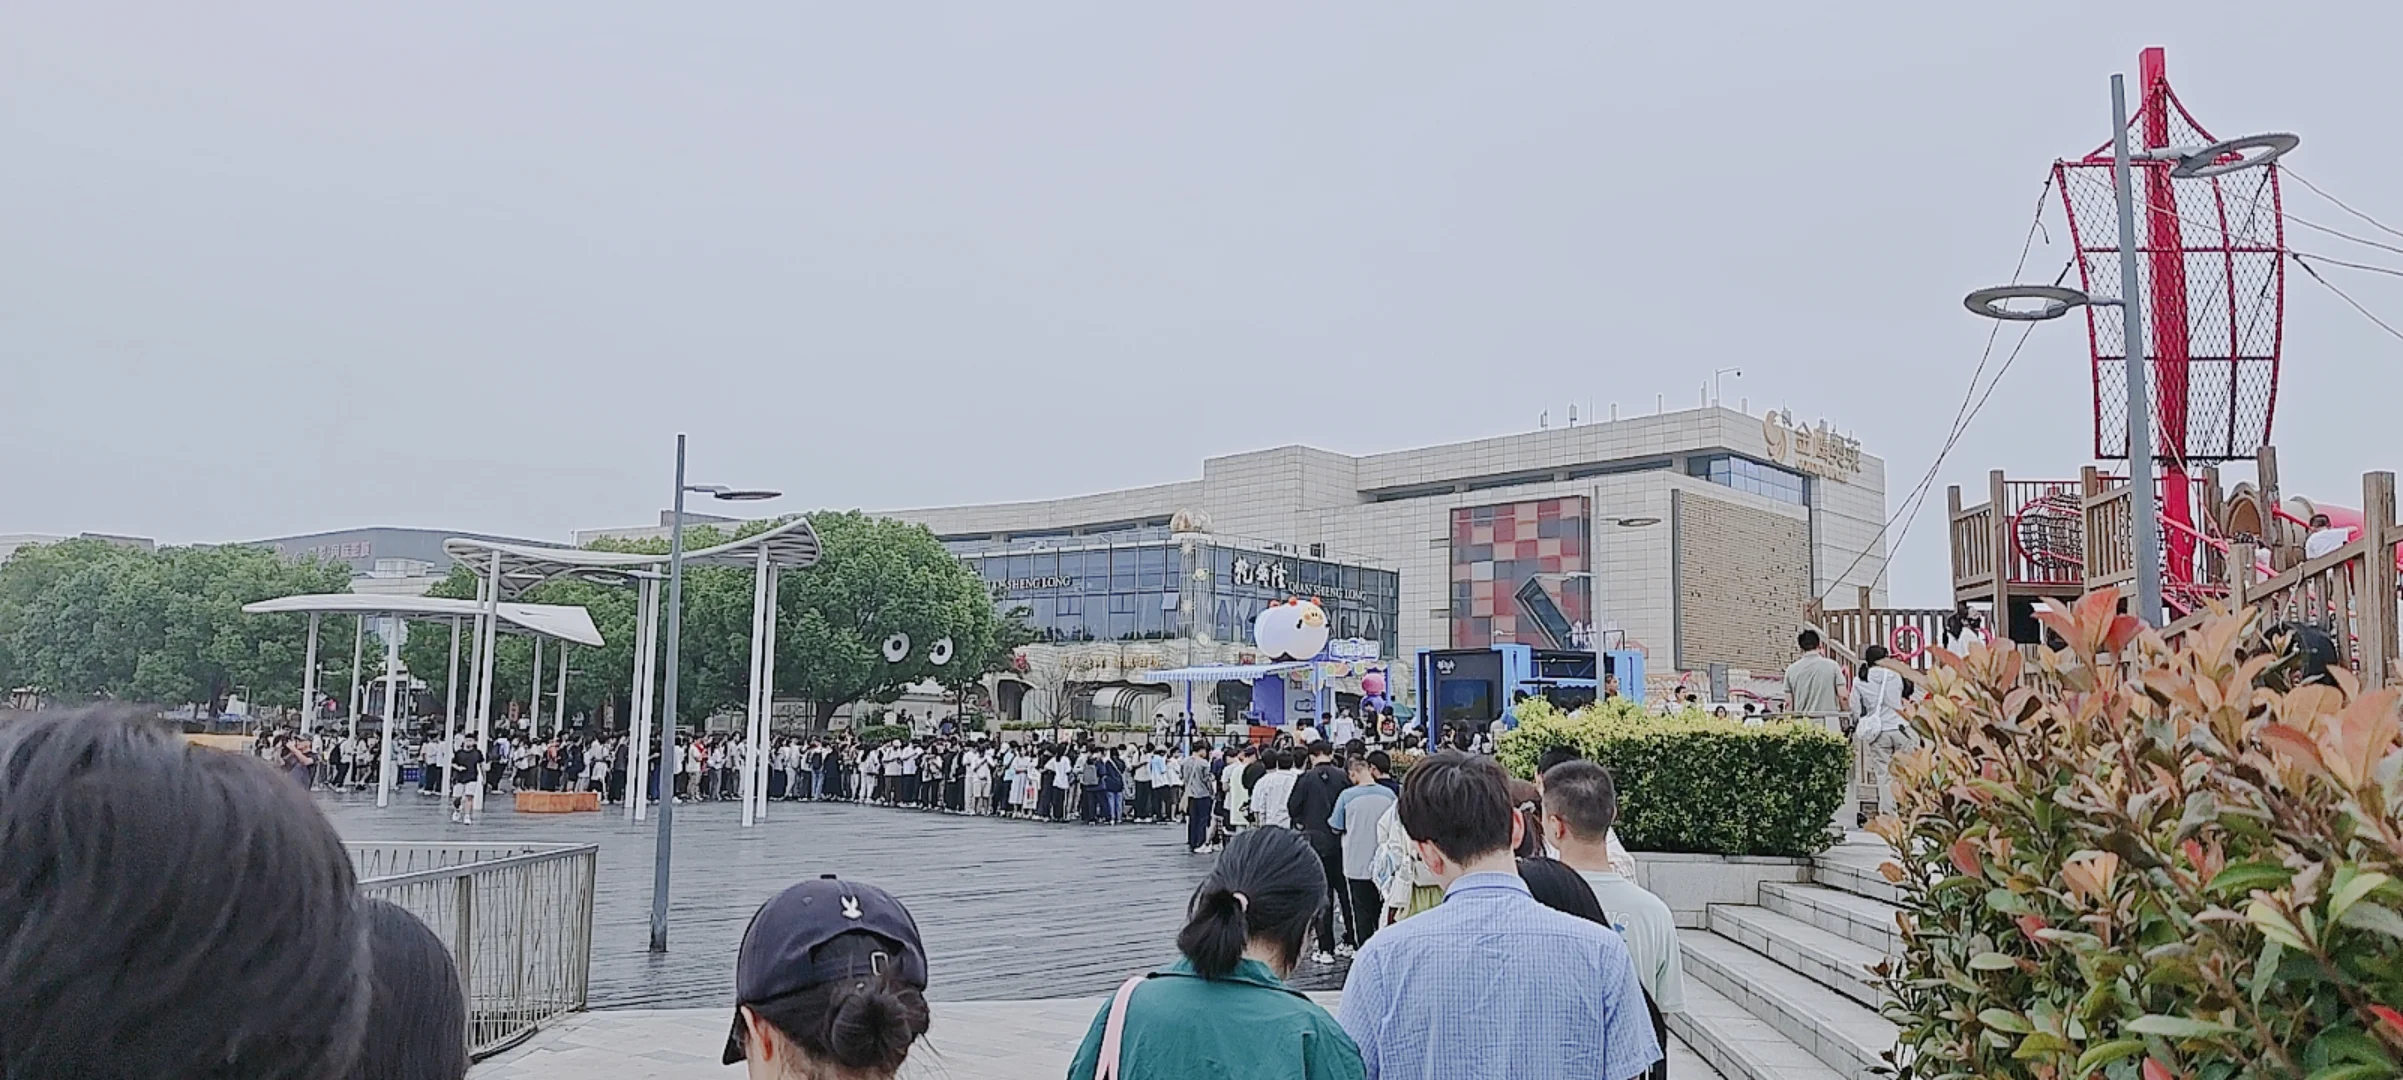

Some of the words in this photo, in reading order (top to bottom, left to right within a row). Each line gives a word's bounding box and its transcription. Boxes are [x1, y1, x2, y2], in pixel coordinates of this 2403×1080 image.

[1007, 577, 1039, 590] SHENG
[1042, 575, 1071, 588] LONG
[1288, 581, 1311, 595] QIAN
[1313, 585, 1341, 598] SHENG
[1344, 589, 1367, 601] LONG
